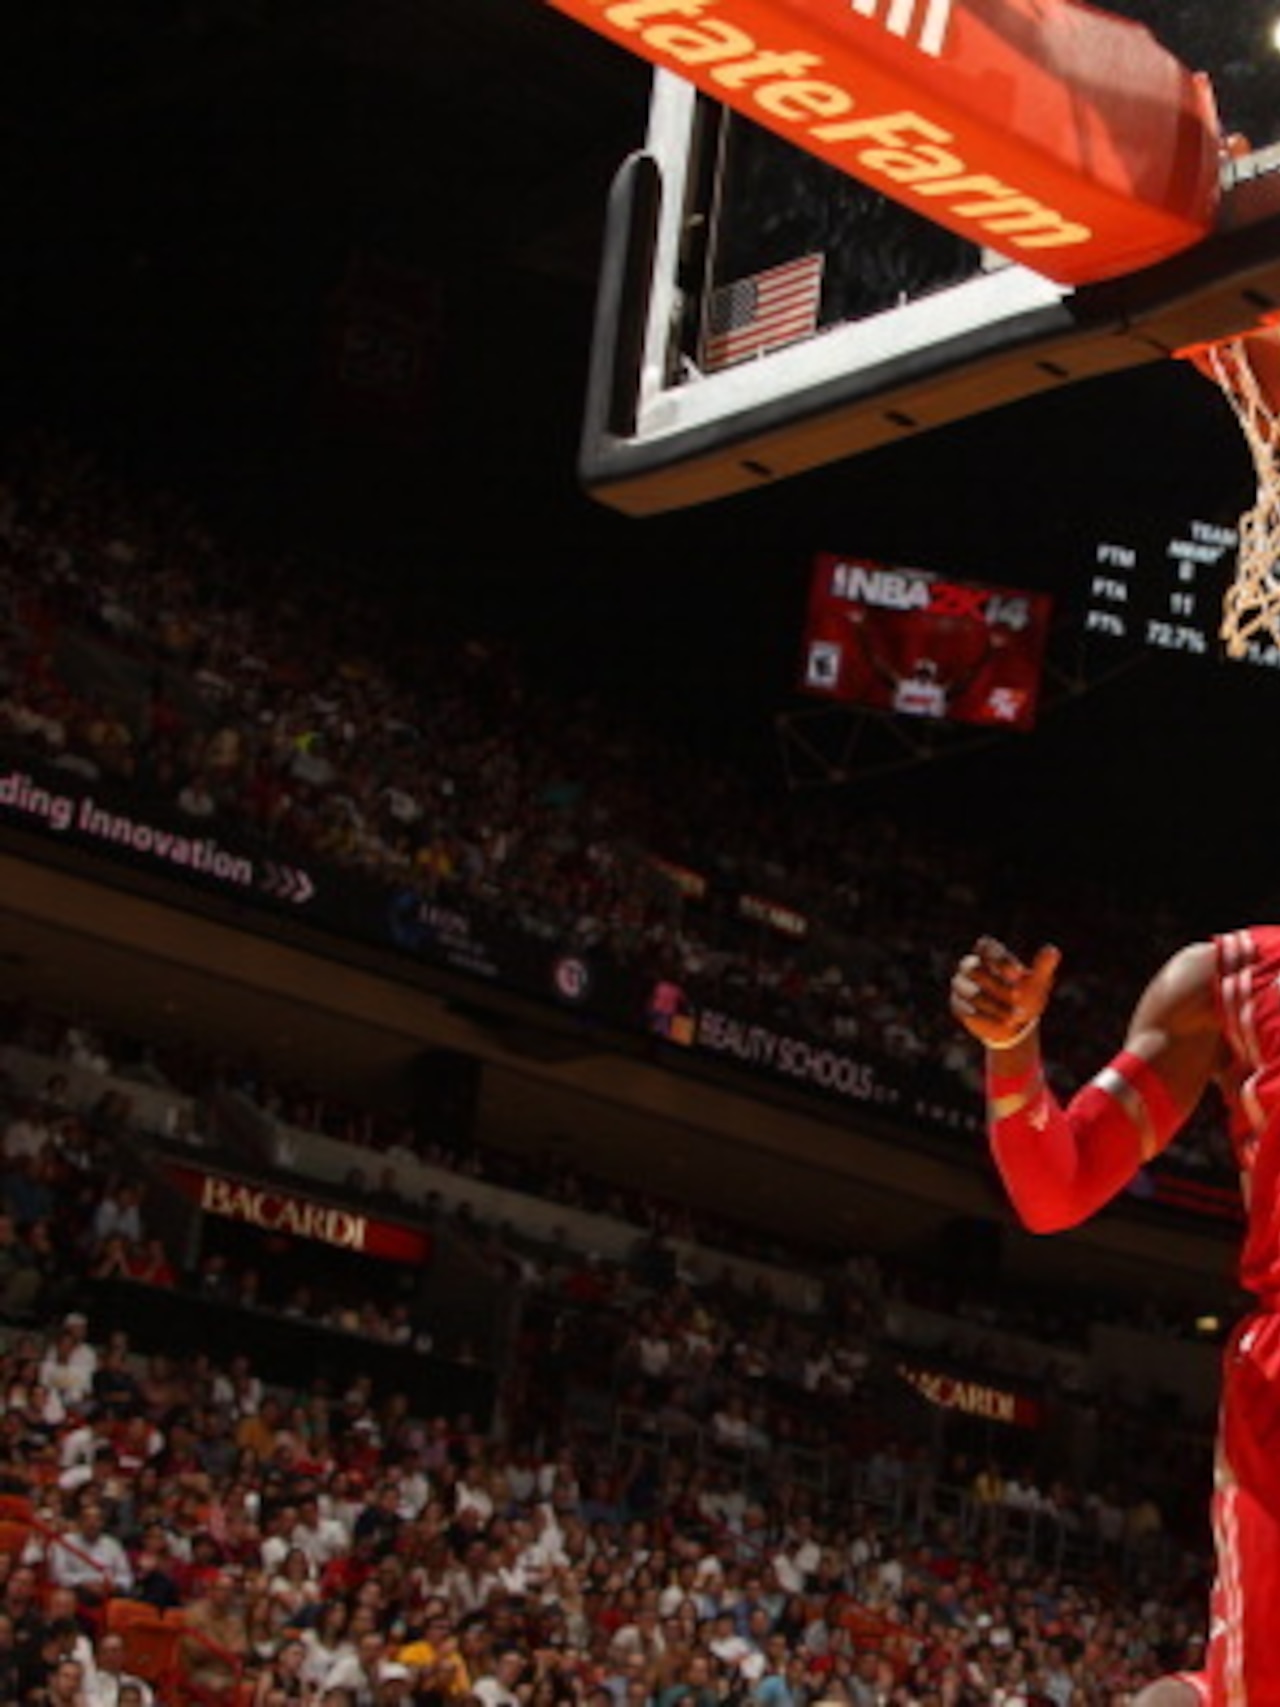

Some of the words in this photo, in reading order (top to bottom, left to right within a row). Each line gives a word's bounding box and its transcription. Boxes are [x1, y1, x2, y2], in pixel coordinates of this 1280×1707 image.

[848, 565, 931, 612] NBA
[78, 796, 252, 887] Innovation
[700, 1008, 777, 1063] BEAUTY
[777, 1036, 874, 1102] SCHOOLS
[201, 1174, 369, 1252] BACARDI
